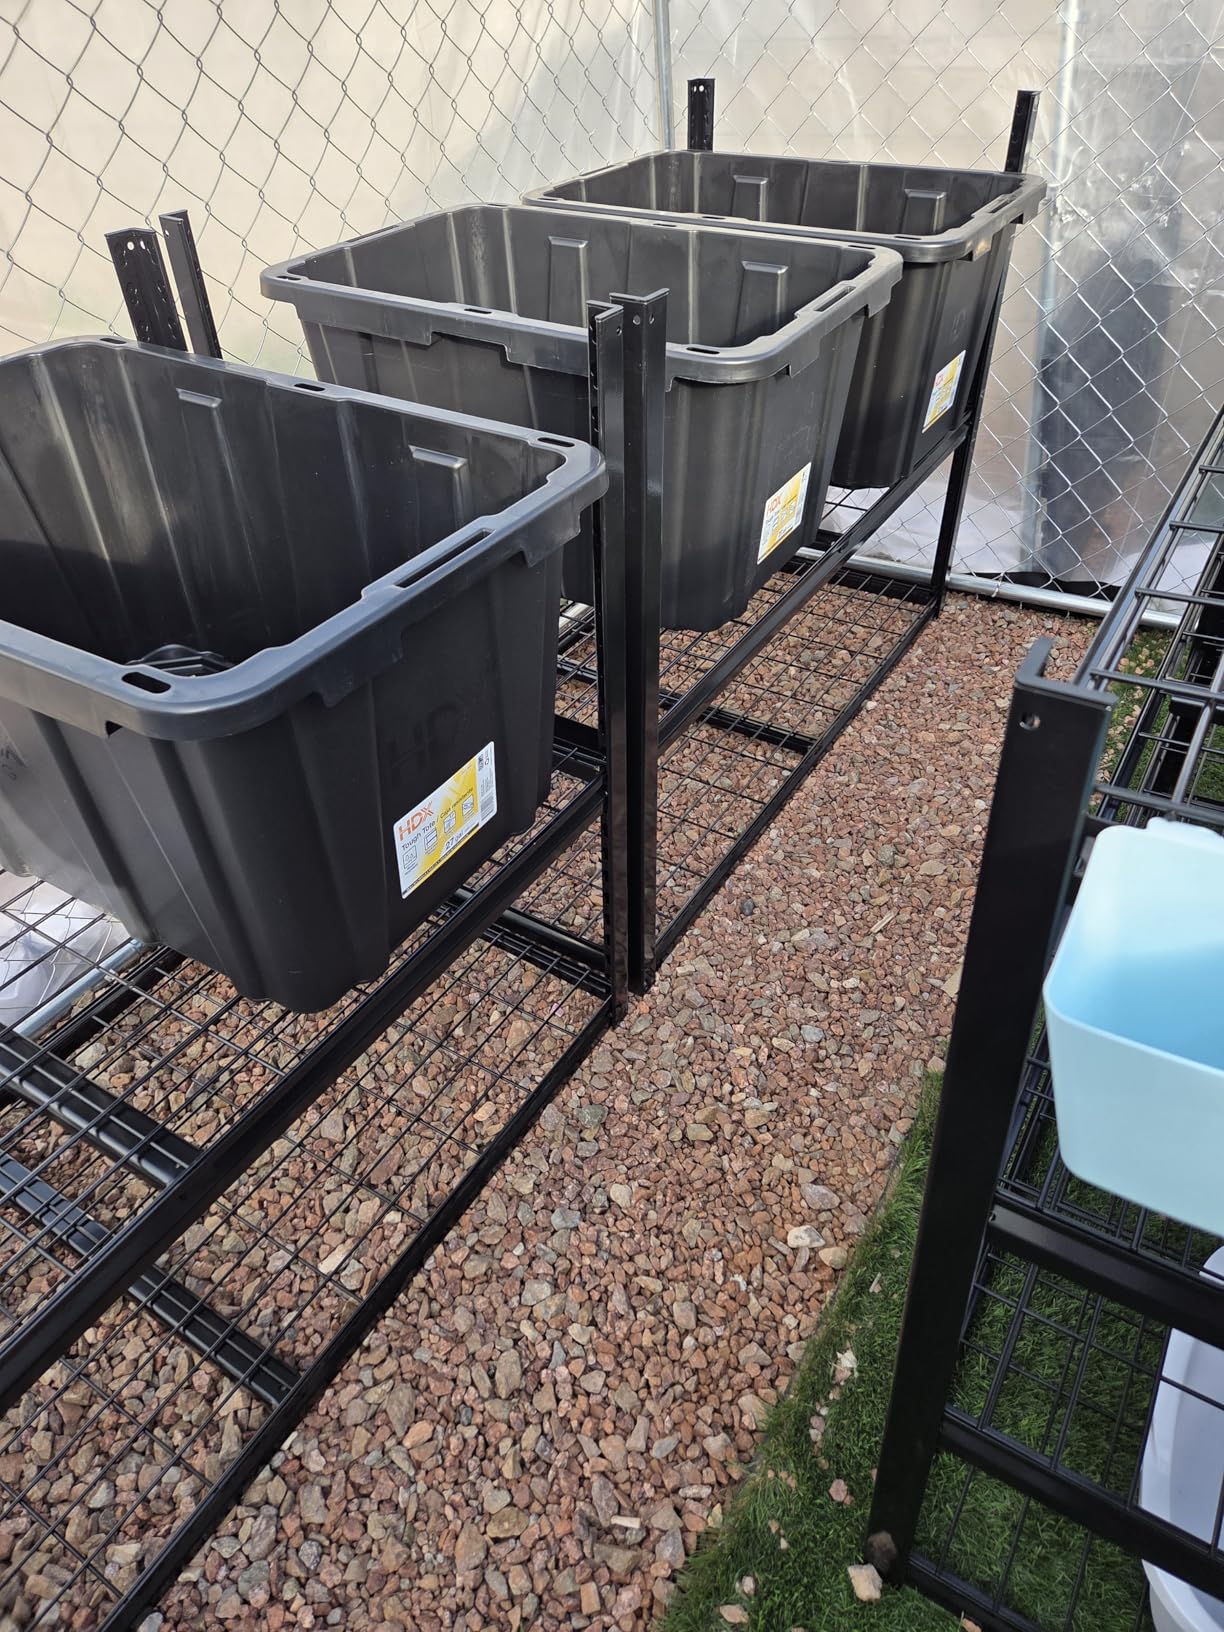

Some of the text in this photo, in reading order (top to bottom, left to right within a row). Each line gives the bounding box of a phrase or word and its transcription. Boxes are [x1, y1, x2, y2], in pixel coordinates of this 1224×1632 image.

[398, 801, 434, 841] HDX
[402, 832, 422, 850] Tough
[422, 820, 436, 834] Tote
[445, 837, 454, 850] 27
[454, 829, 464, 842] gal
